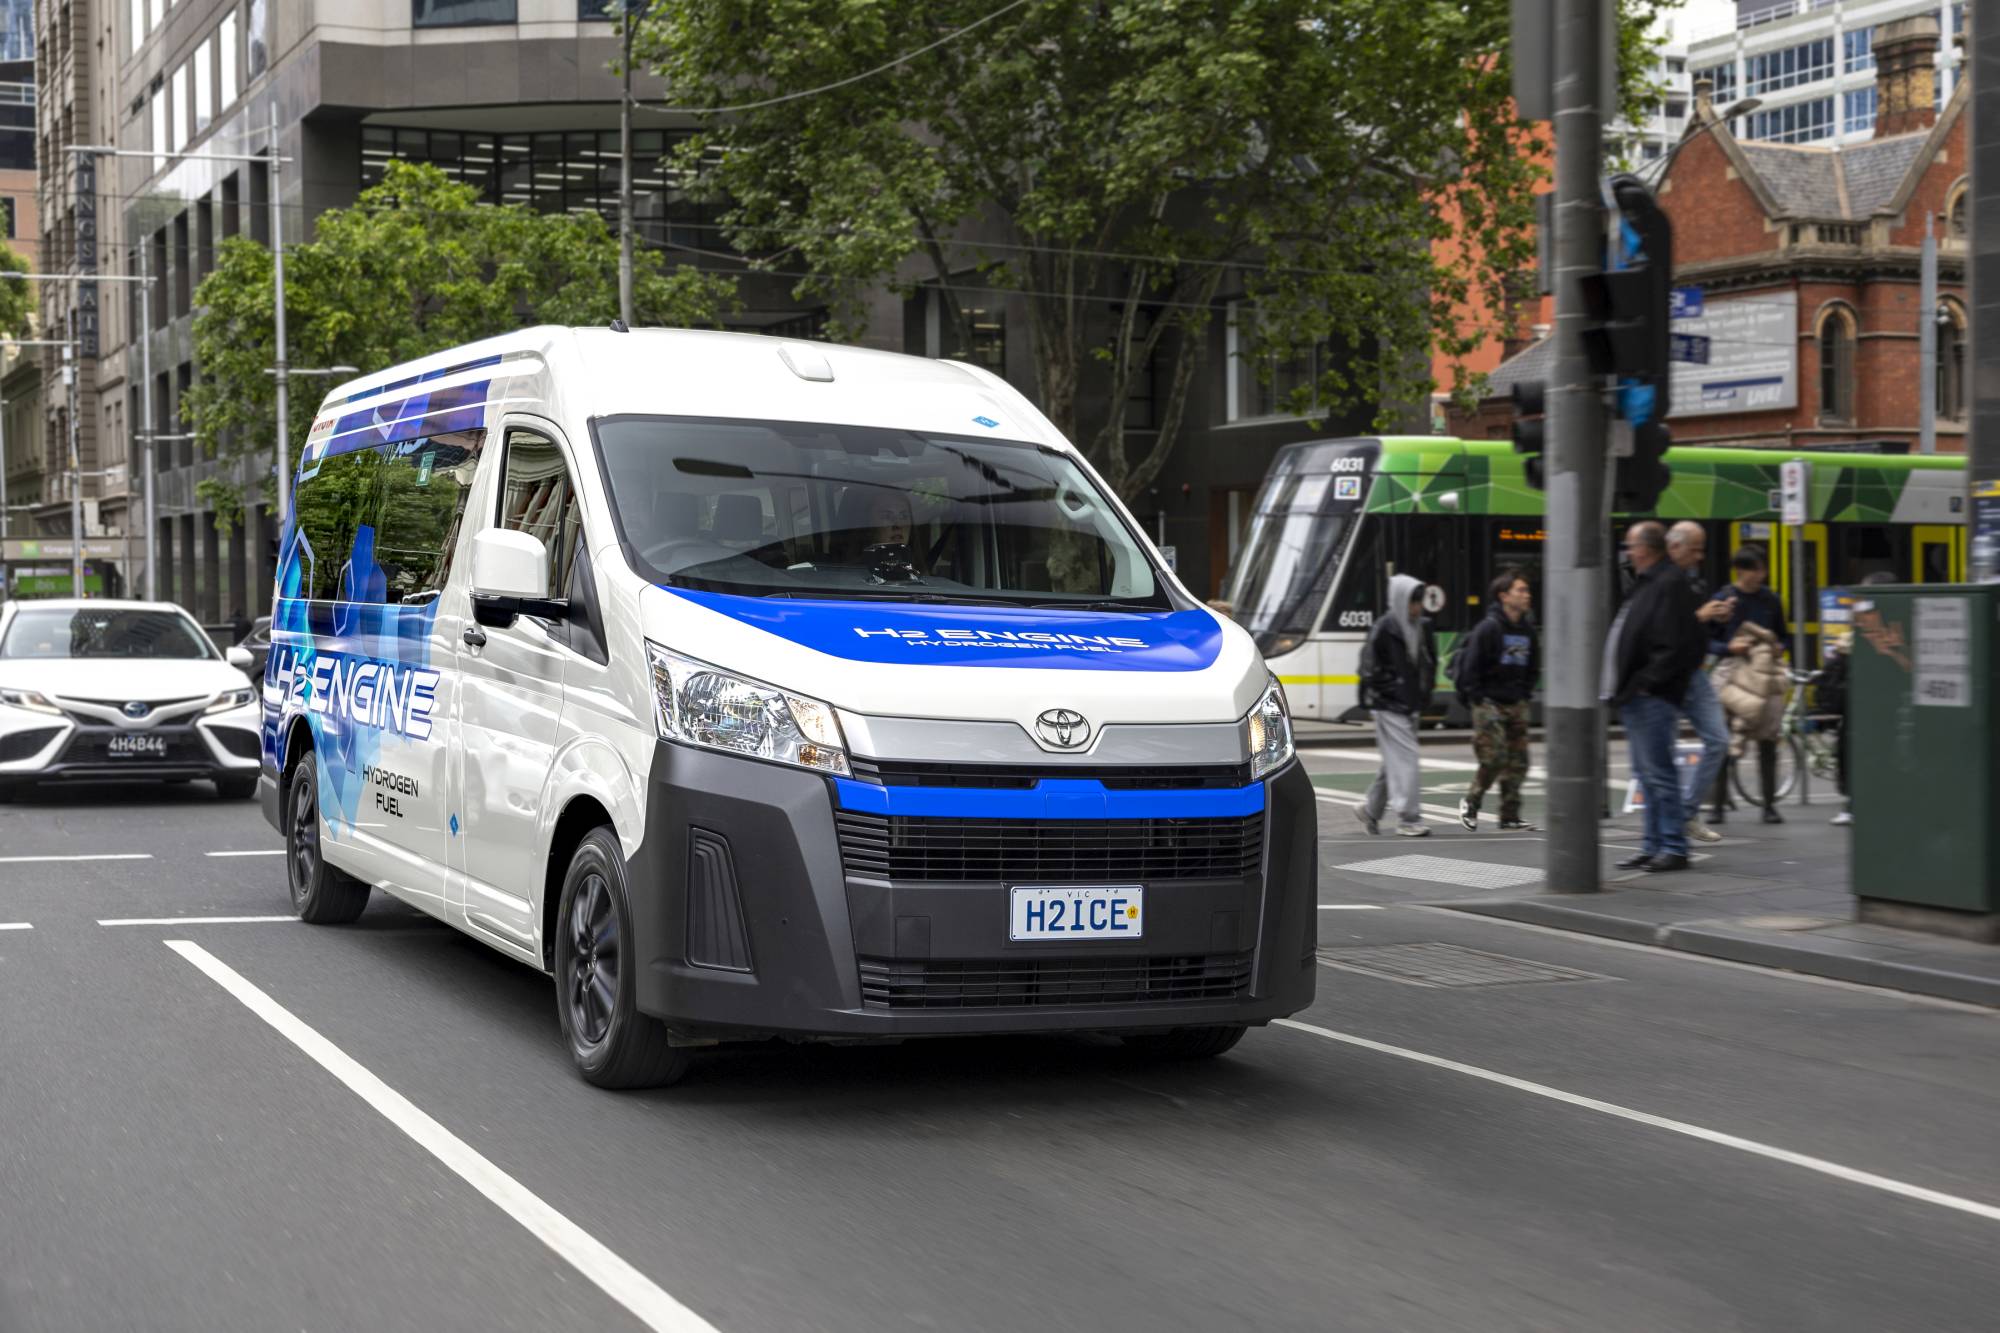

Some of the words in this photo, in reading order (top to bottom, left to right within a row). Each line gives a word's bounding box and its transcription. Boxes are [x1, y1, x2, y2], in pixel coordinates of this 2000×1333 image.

[1331, 457, 1365, 472] 6031
[1339, 611, 1373, 627] 6031
[853, 628, 928, 638] H2
[936, 629, 1149, 648] ENGINE
[906, 640, 1049, 650] HYDROGEN
[309, 656, 440, 741] ENGINE
[362, 764, 419, 797] HYDROGEN
[376, 792, 403, 818] FUEL
[1026, 899, 1129, 932] H2ICE
